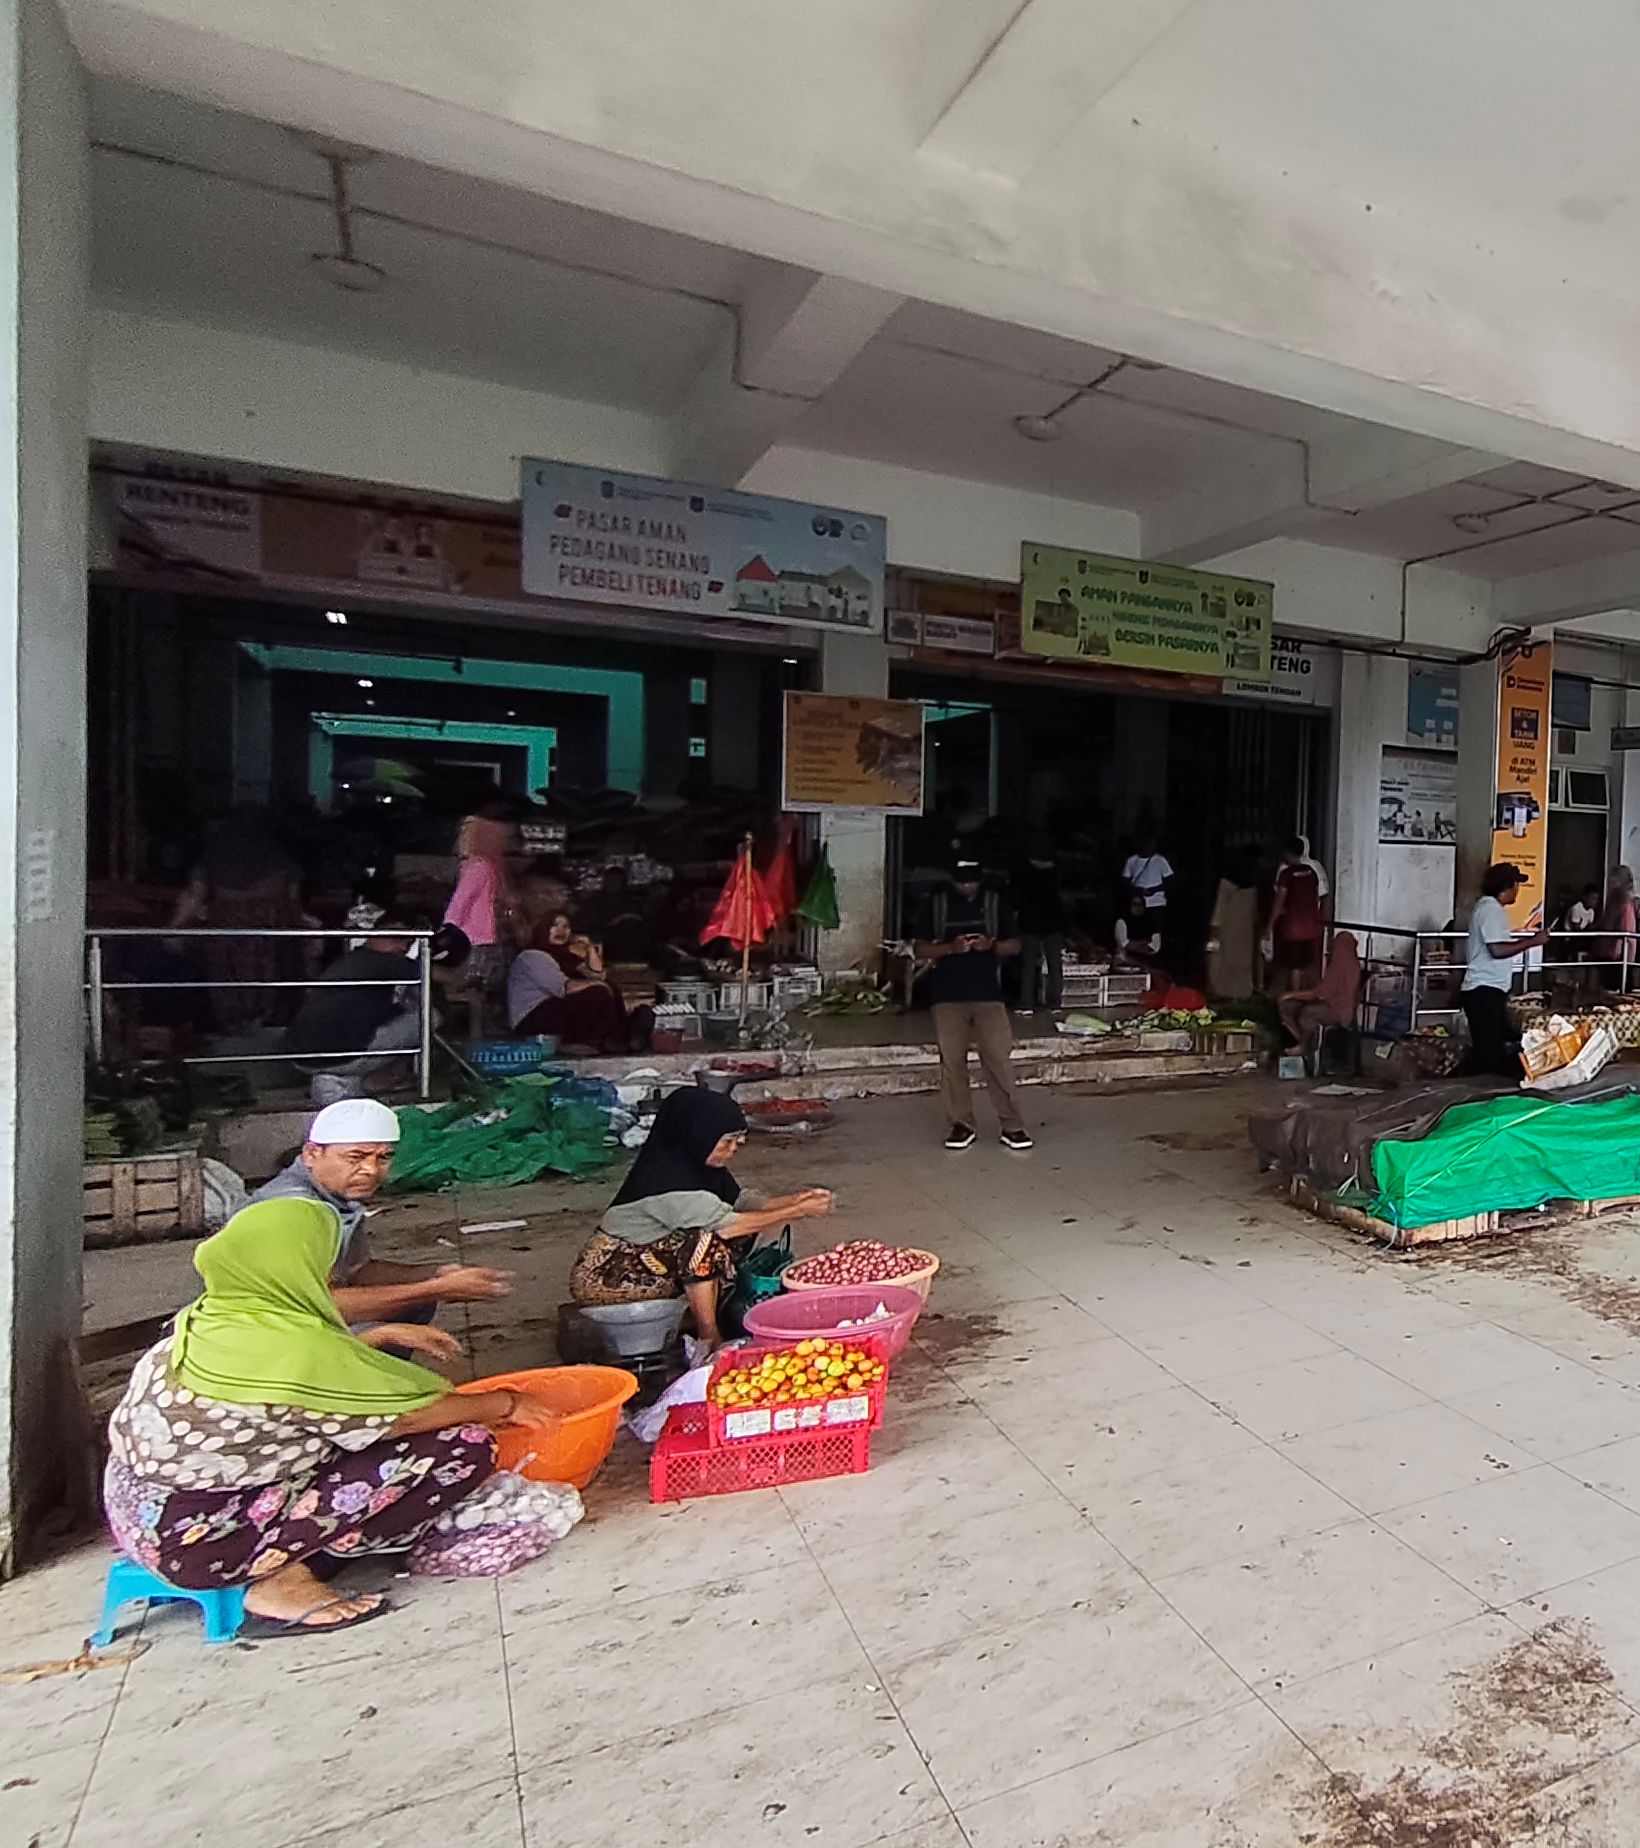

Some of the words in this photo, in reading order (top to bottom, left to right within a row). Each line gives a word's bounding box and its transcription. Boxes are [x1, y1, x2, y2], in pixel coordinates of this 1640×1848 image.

[576, 508, 632, 533] PASAR
[637, 520, 687, 543] AMAN
[550, 534, 642, 566] PEDAGANG
[645, 548, 710, 576] SENANG
[560, 563, 632, 592] PEMBELI
[635, 575, 701, 601] TENANG
[1081, 586, 1117, 603] AMAN
[1115, 629, 1155, 646] BERSIH
[1270, 639, 1301, 654] SAR
[1270, 655, 1311, 674] TENG
